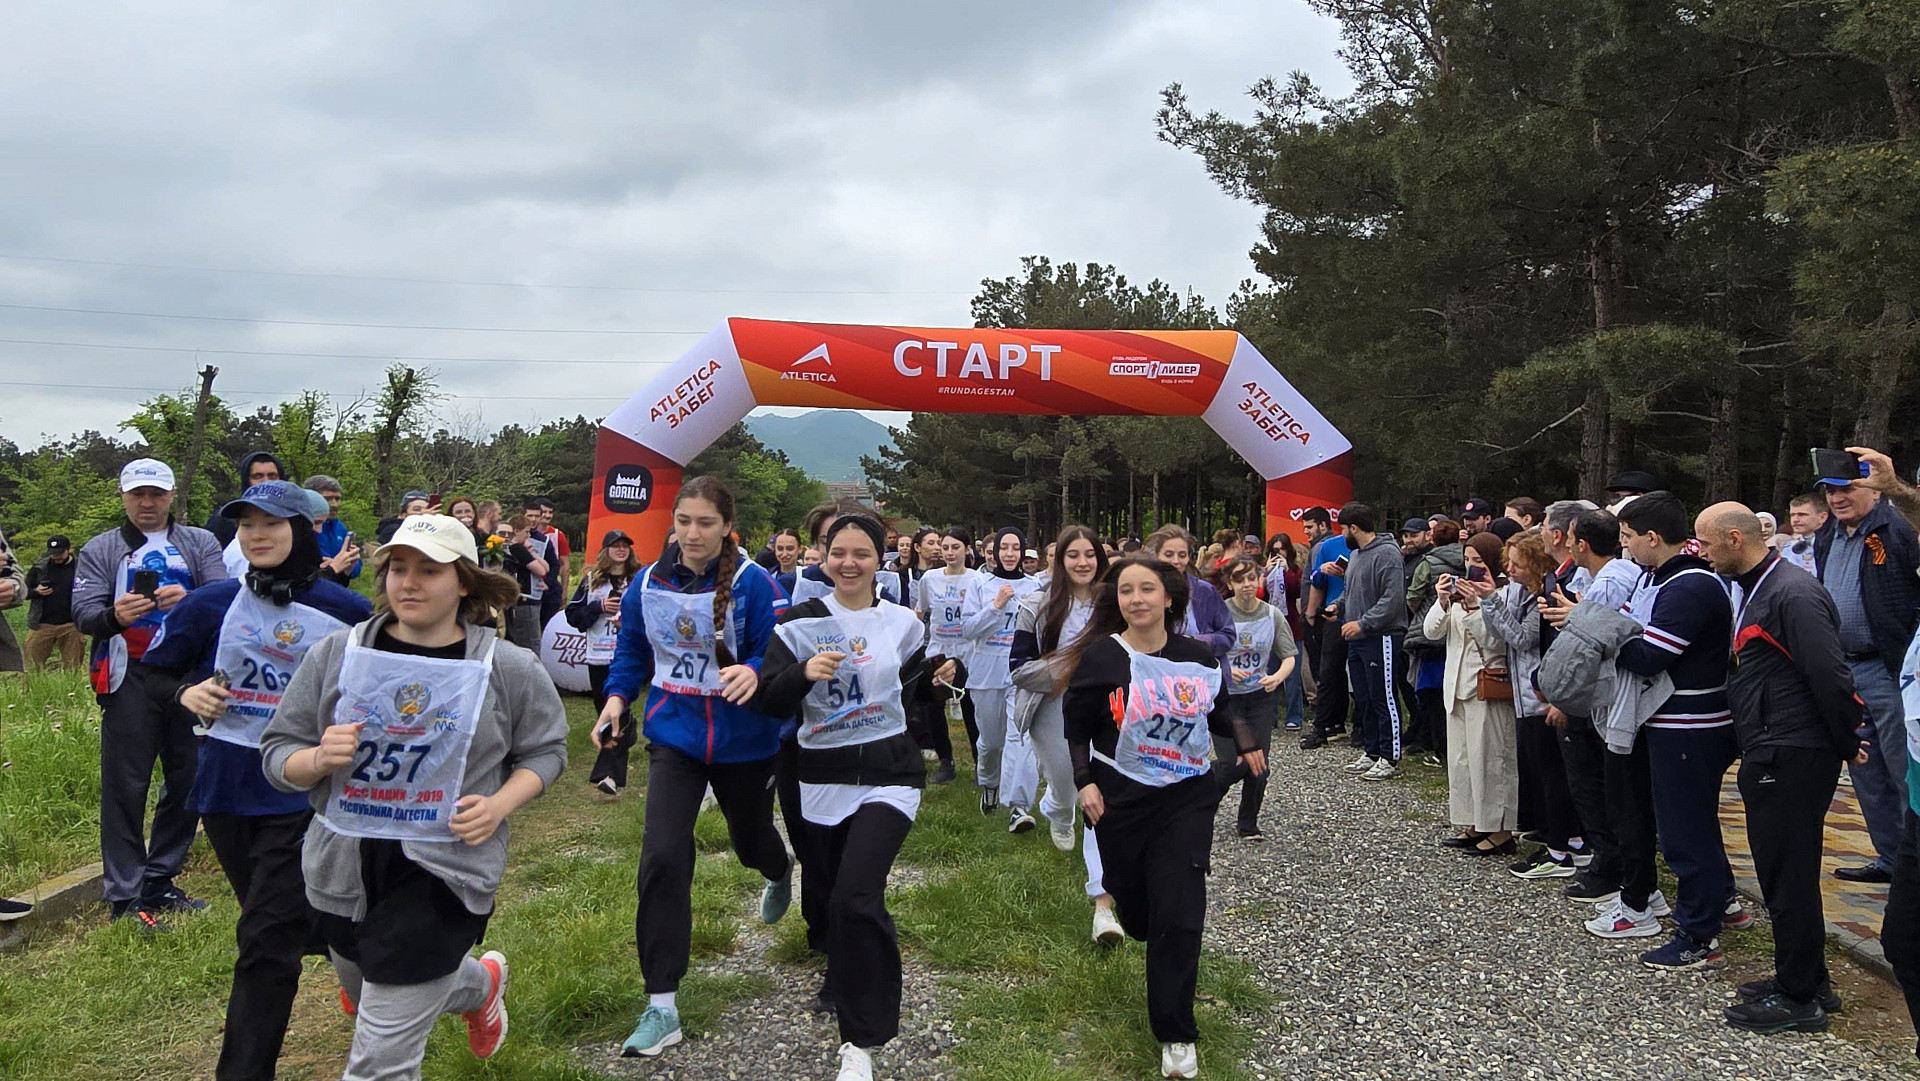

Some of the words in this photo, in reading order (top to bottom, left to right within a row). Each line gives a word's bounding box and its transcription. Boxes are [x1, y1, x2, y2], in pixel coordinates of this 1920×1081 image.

[893, 340, 1062, 380] СТАРТ
[1112, 365, 1146, 374] СПОРТ
[1161, 366, 1197, 374] ЛИДЕР
[780, 371, 837, 383] ATLETICA
[650, 360, 722, 422] ATLETICA
[938, 386, 1016, 397] #RUNDAGESTAN
[666, 381, 715, 429] ЗАБЕГ
[1242, 382, 1310, 445] ATLETICA
[1238, 398, 1290, 441] ЗАБЕГ
[609, 485, 647, 500] GORILLA
[945, 605, 961, 622] 64
[671, 652, 709, 683] 267
[1232, 652, 1261, 669] 439
[828, 674, 864, 708] 54
[852, 713, 887, 729] ДАГЕСТАН
[1146, 713, 1196, 746] 277
[351, 740, 432, 783] 257
[370, 787, 407, 802] НАЦИИ
[416, 790, 443, 803] 2019
[339, 799, 392, 818] РЕСПУБЛИКА
[393, 807, 438, 822] ДАГЕСТАН
